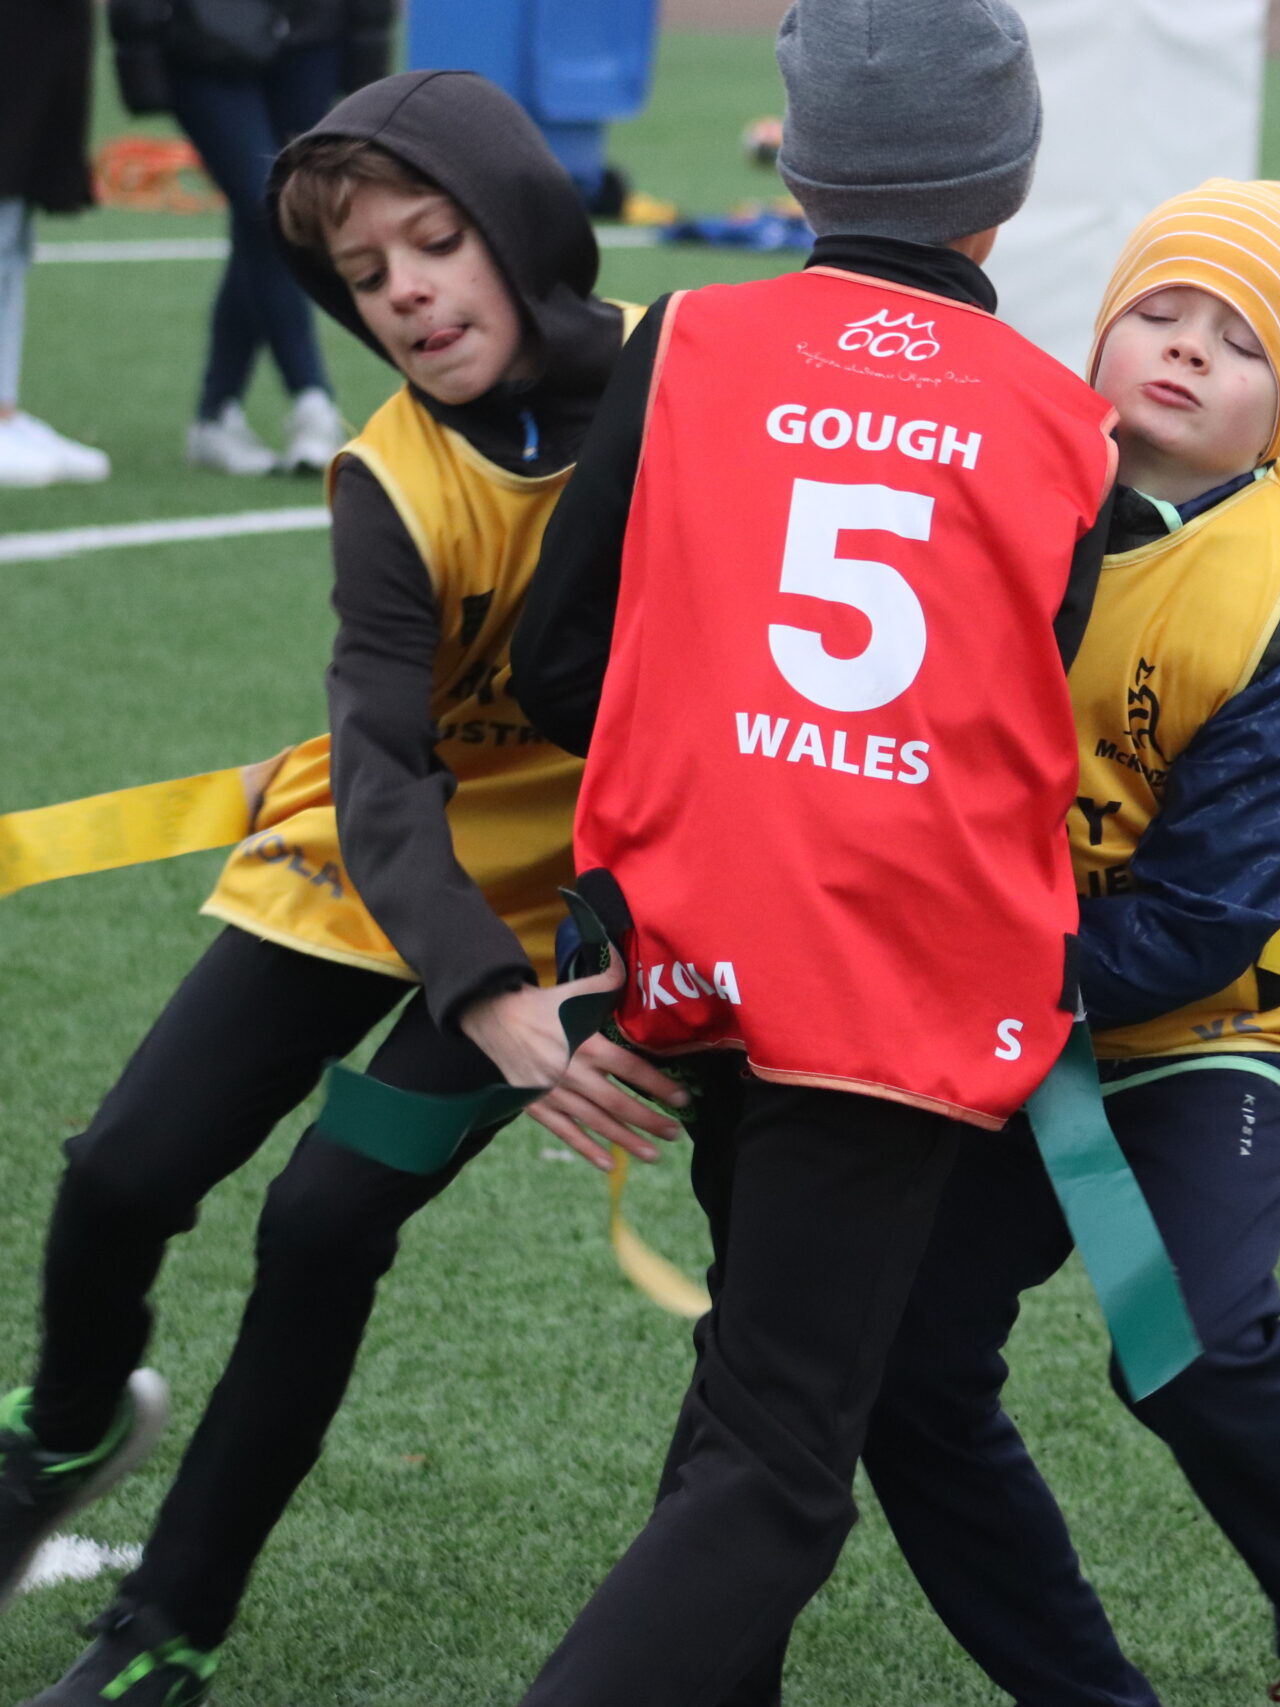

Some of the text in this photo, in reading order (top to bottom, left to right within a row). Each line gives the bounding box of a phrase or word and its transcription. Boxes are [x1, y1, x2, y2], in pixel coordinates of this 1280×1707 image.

[766, 404, 982, 470] GOUGH
[768, 478, 936, 712] 5
[735, 712, 930, 785] WALES
[994, 1018, 1024, 1061] S
[1240, 1093, 1257, 1156] KIPSTA
